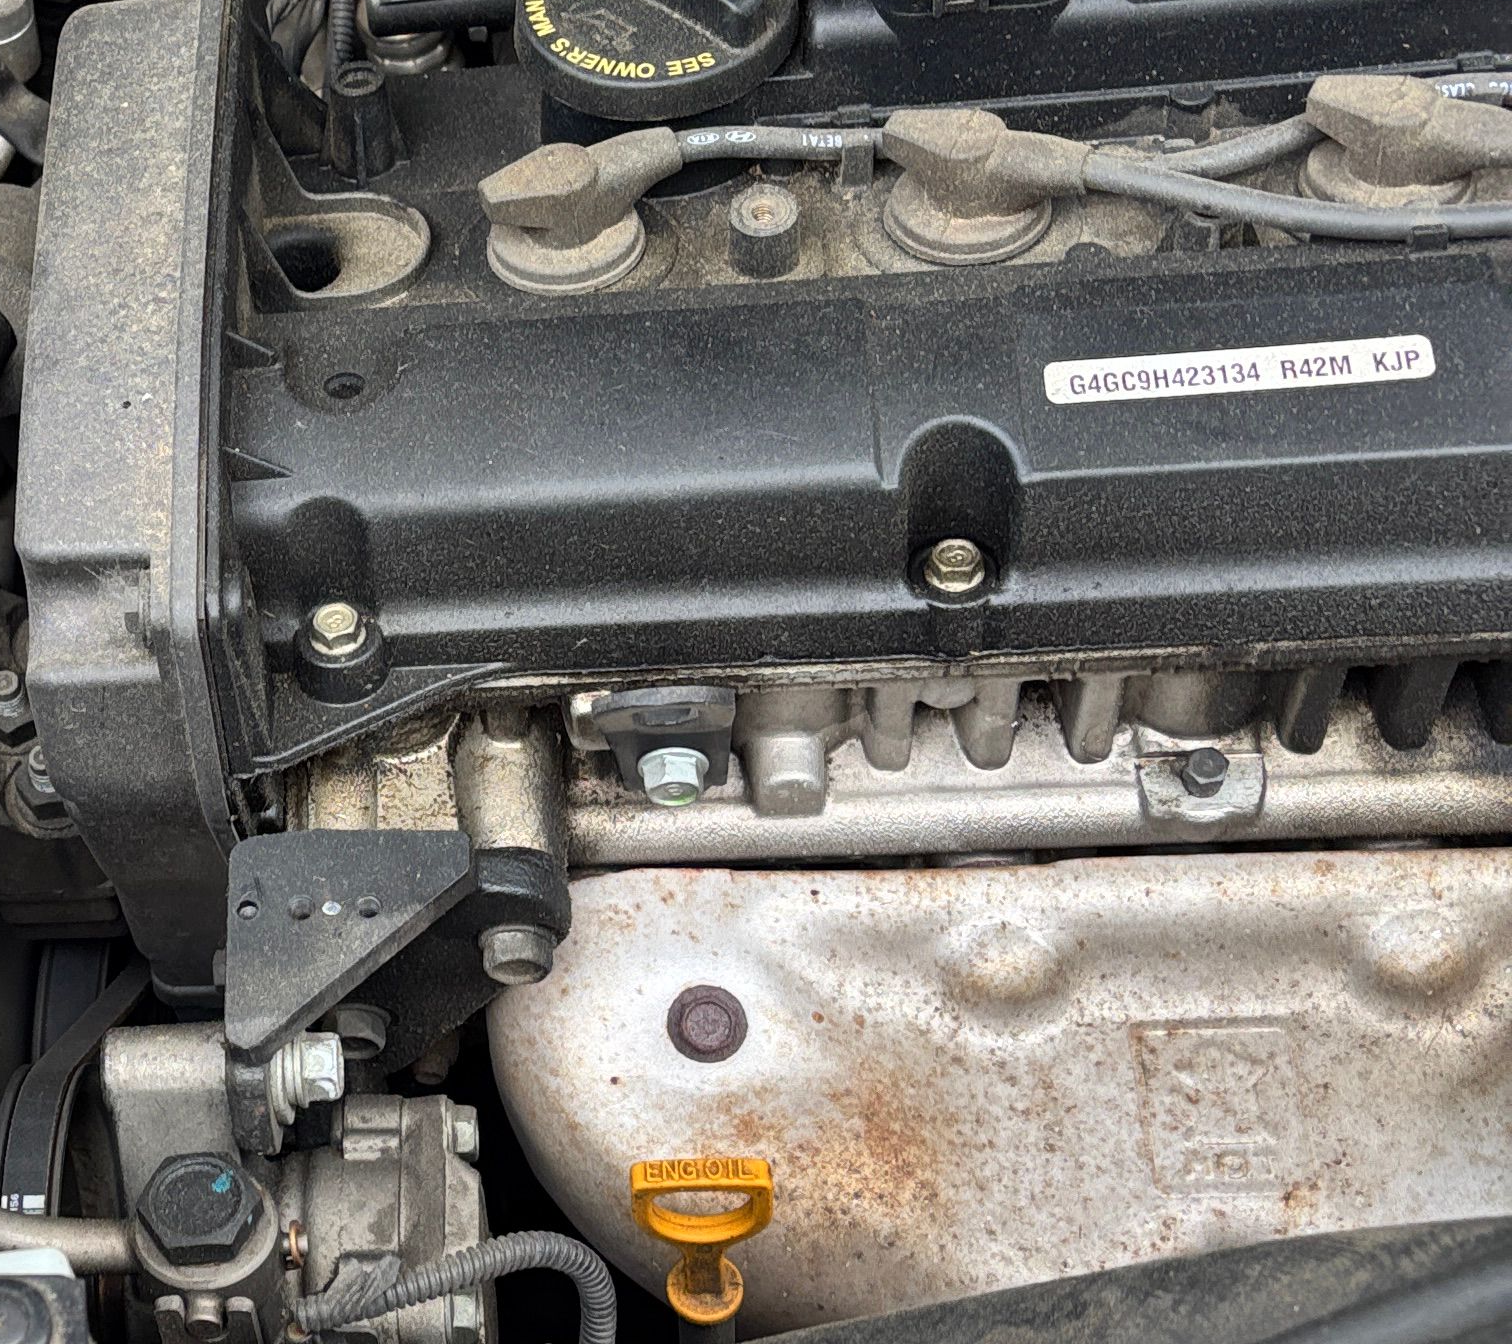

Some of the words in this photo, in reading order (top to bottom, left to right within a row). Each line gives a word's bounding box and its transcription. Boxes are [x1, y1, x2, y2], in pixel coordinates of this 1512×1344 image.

[550, 36, 656, 79] OWNER'S
[665, 52, 716, 77] SEE
[1069, 361, 1261, 396] G4GC9H423134
[1281, 354, 1353, 380] R42M
[1371, 349, 1421, 374] KJP
[644, 1159, 697, 1183] ENG
[704, 1158, 756, 1181] OIL
